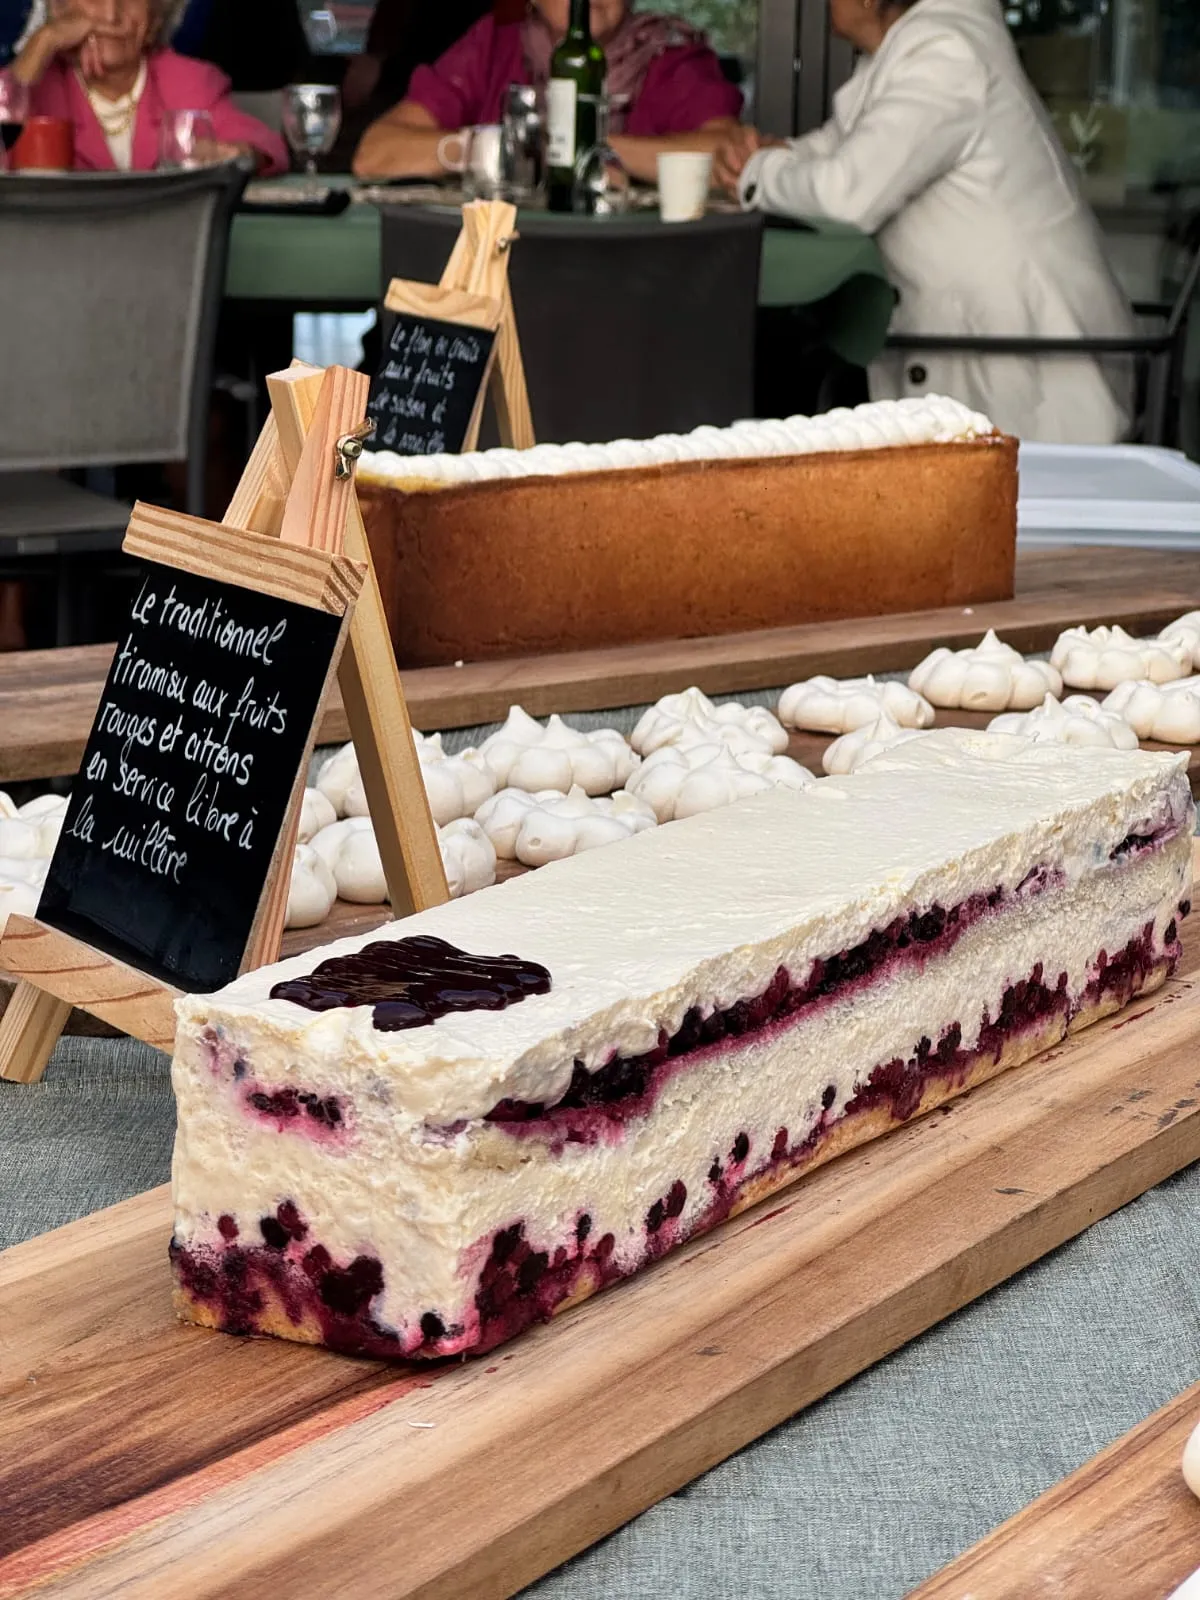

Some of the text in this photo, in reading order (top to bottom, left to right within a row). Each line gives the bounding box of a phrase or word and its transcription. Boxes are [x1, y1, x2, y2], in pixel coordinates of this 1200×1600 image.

[131, 575, 288, 664] Le traditionnel
[112, 632, 288, 745] tiramisu aux fruits
[97, 702, 254, 785] rouges et citrons
[65, 794, 95, 843] la
[86, 751, 260, 850] en service libre à
